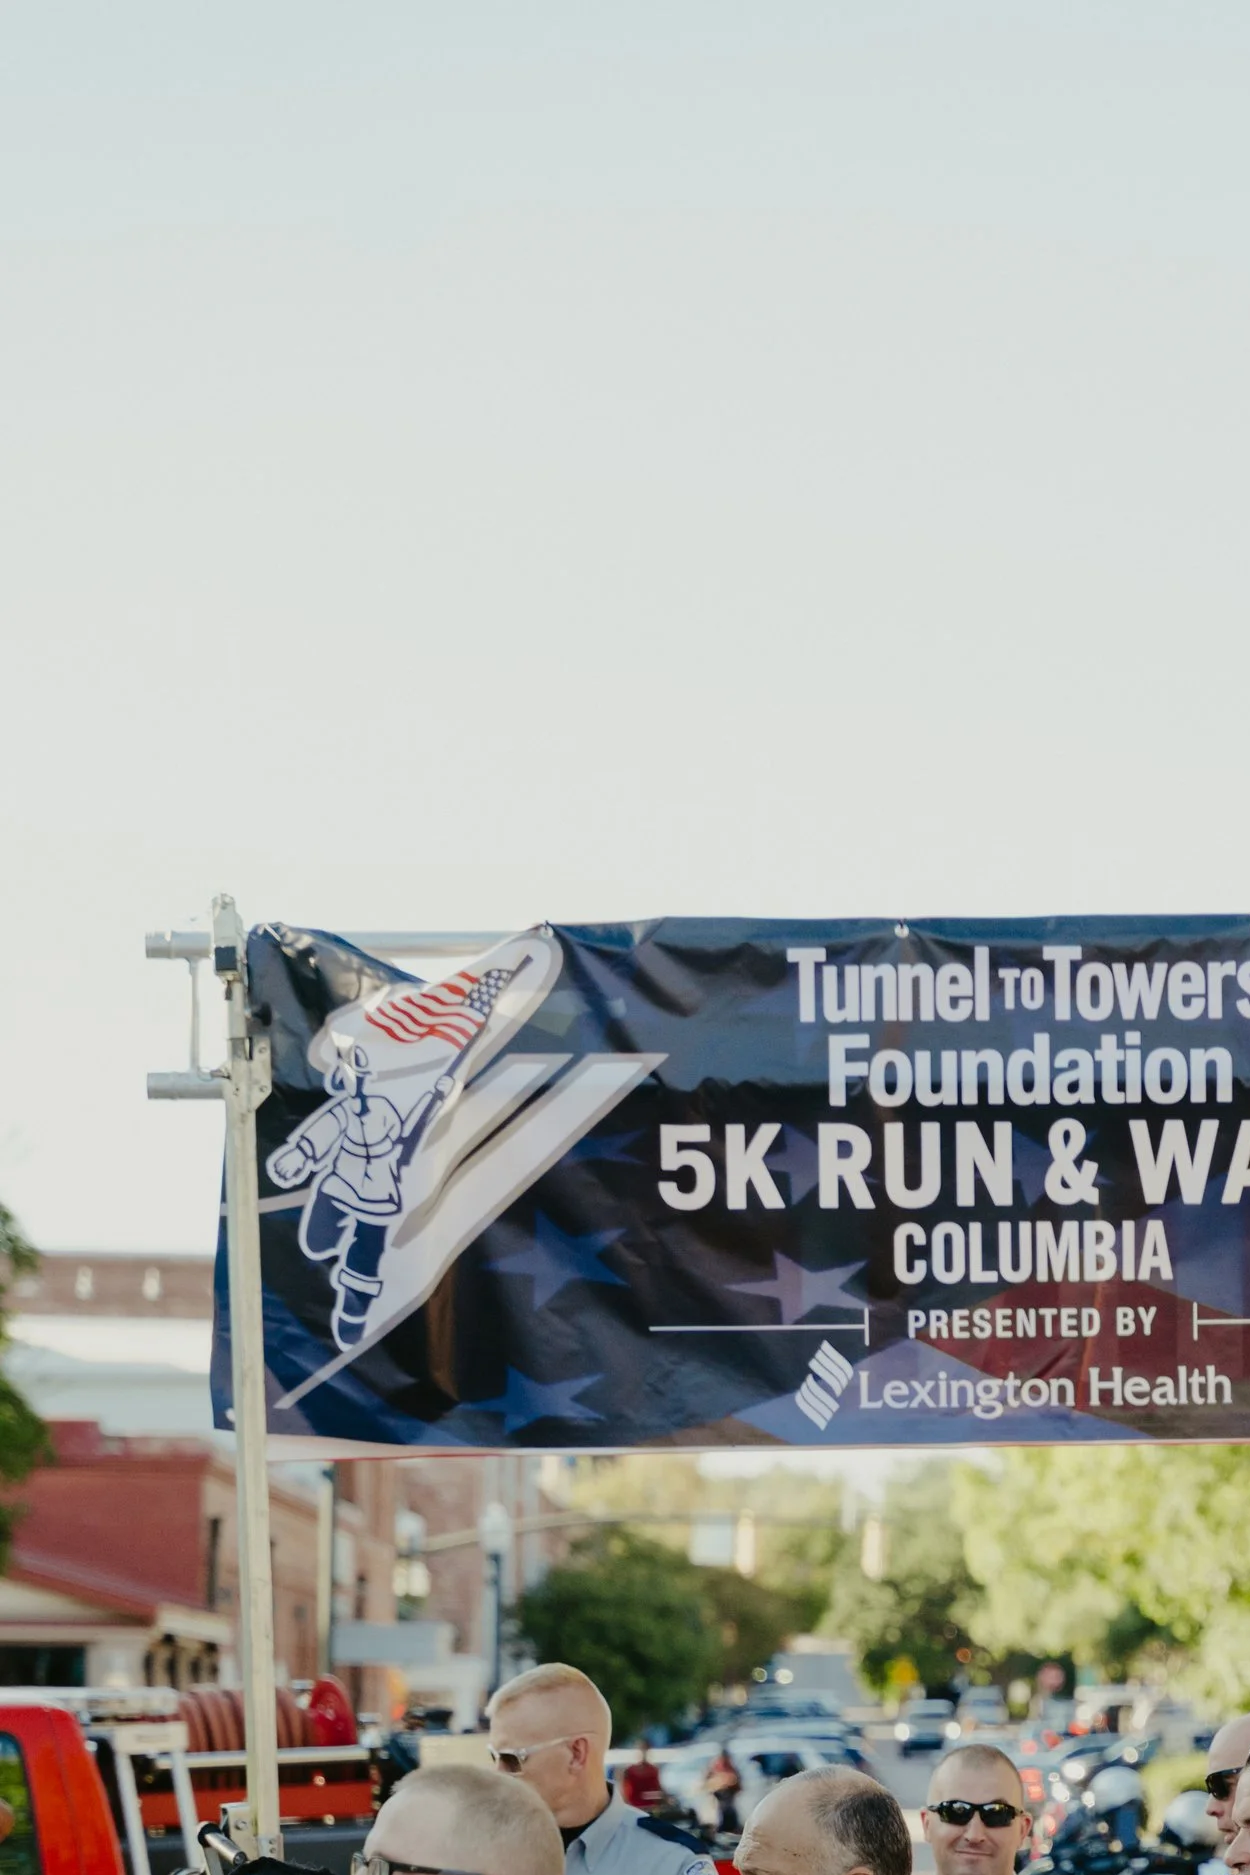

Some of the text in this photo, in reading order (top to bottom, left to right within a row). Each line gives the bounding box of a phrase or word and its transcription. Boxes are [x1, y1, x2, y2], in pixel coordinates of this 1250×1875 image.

[786, 945, 990, 1024] Tunnel
[999, 967, 1044, 1011] TO
[827, 1031, 1234, 1107] Foundation
[657, 1121, 786, 1211] 5K
[817, 1120, 1014, 1210] RUN
[1045, 1116, 1102, 1206] &
[893, 1219, 1174, 1286] COLUMBIA
[907, 1305, 1158, 1339] PRESENTED BY
[858, 1364, 1234, 1420] Lexington Health
